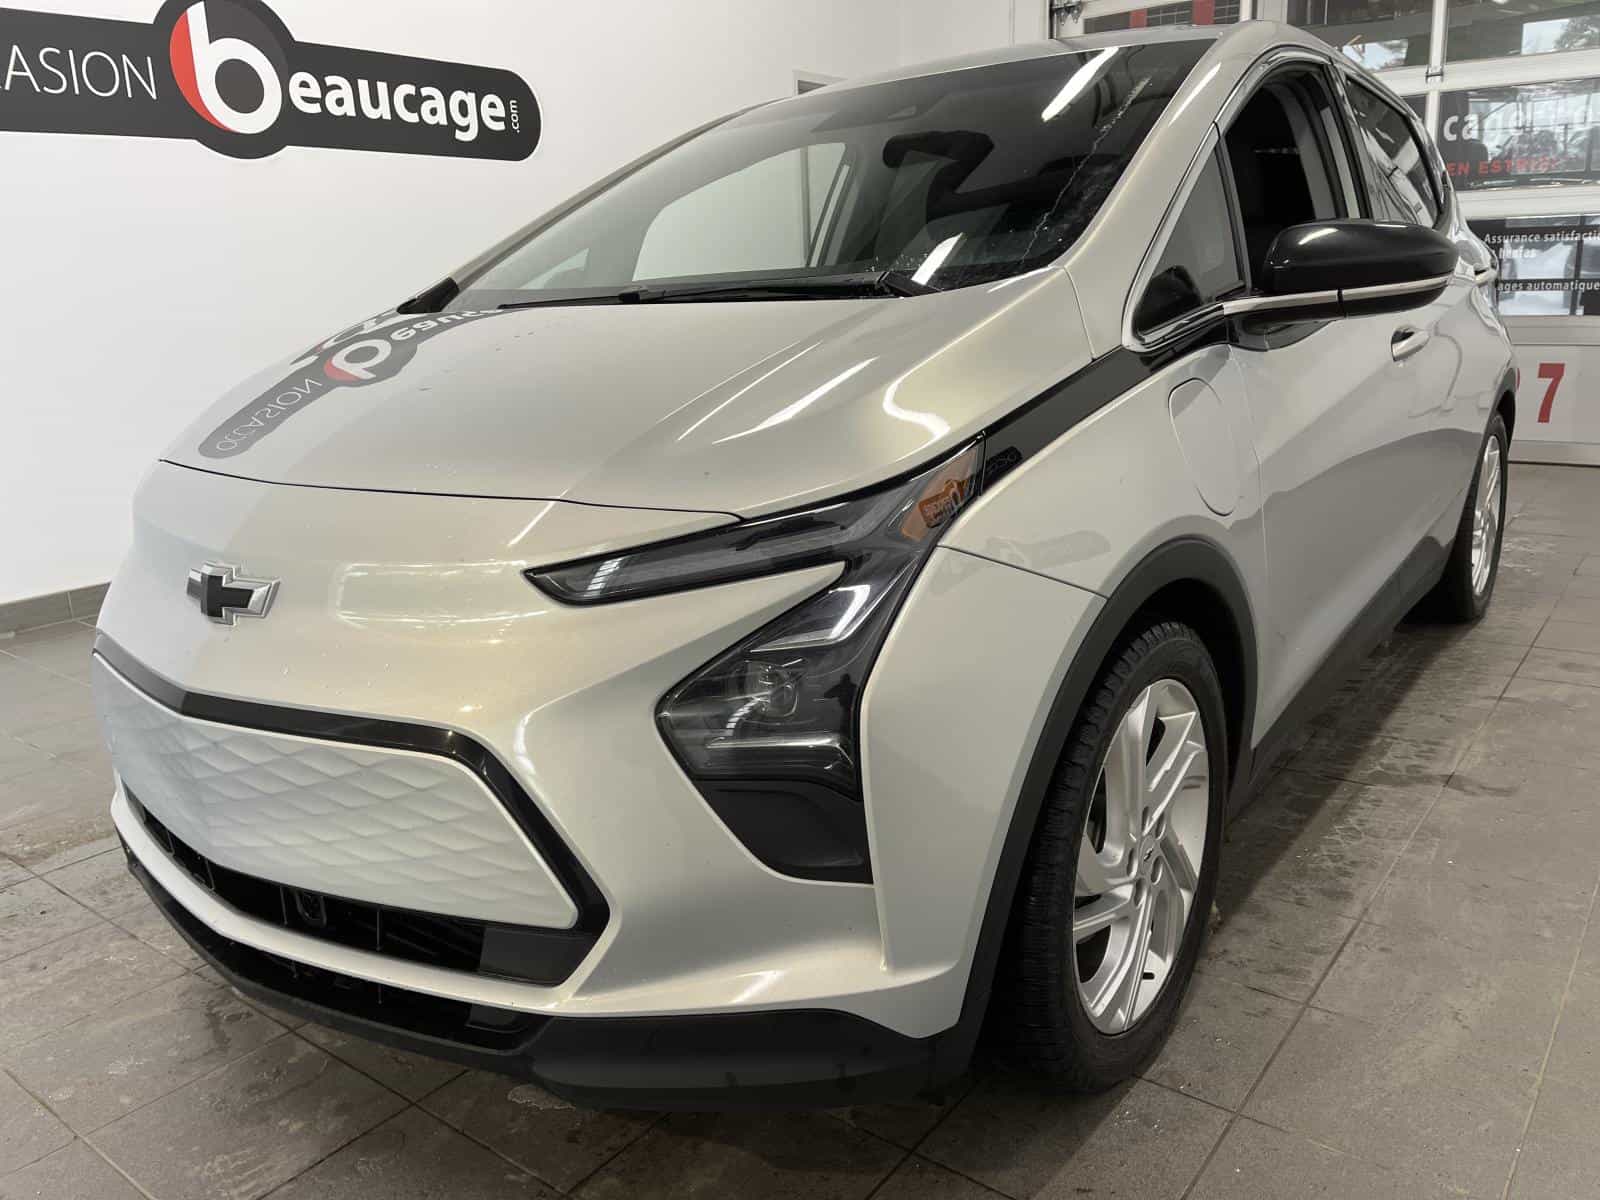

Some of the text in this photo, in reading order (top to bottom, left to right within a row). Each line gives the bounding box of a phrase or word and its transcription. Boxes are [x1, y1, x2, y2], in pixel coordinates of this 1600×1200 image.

[0, 44, 157, 100] ASION
[1484, 233, 1541, 244] Assurance
[1537, 363, 1566, 424] 7
